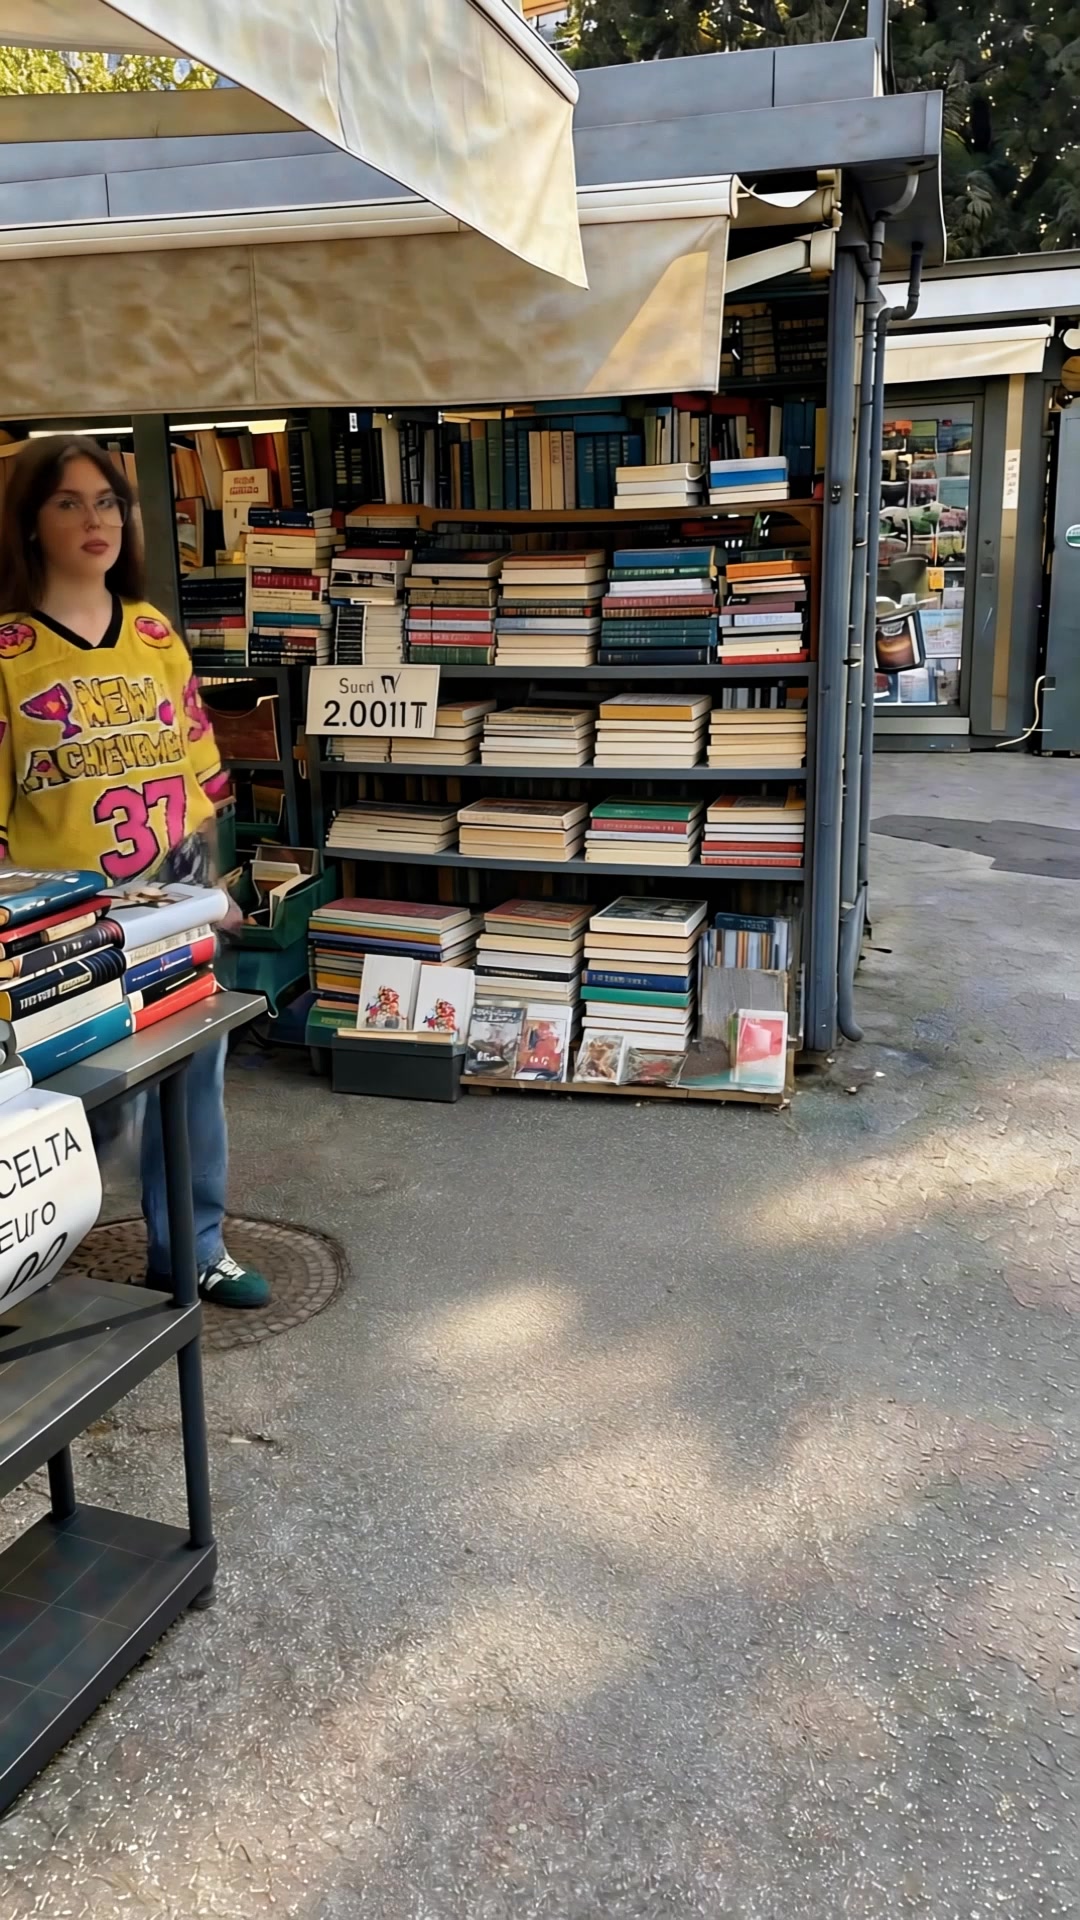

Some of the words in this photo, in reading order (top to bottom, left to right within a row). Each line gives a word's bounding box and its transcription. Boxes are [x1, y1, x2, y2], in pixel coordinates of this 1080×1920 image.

[73, 676, 157, 728] NEW
[93, 775, 187, 879] 37
[0, 1127, 82, 1199] CELTA
